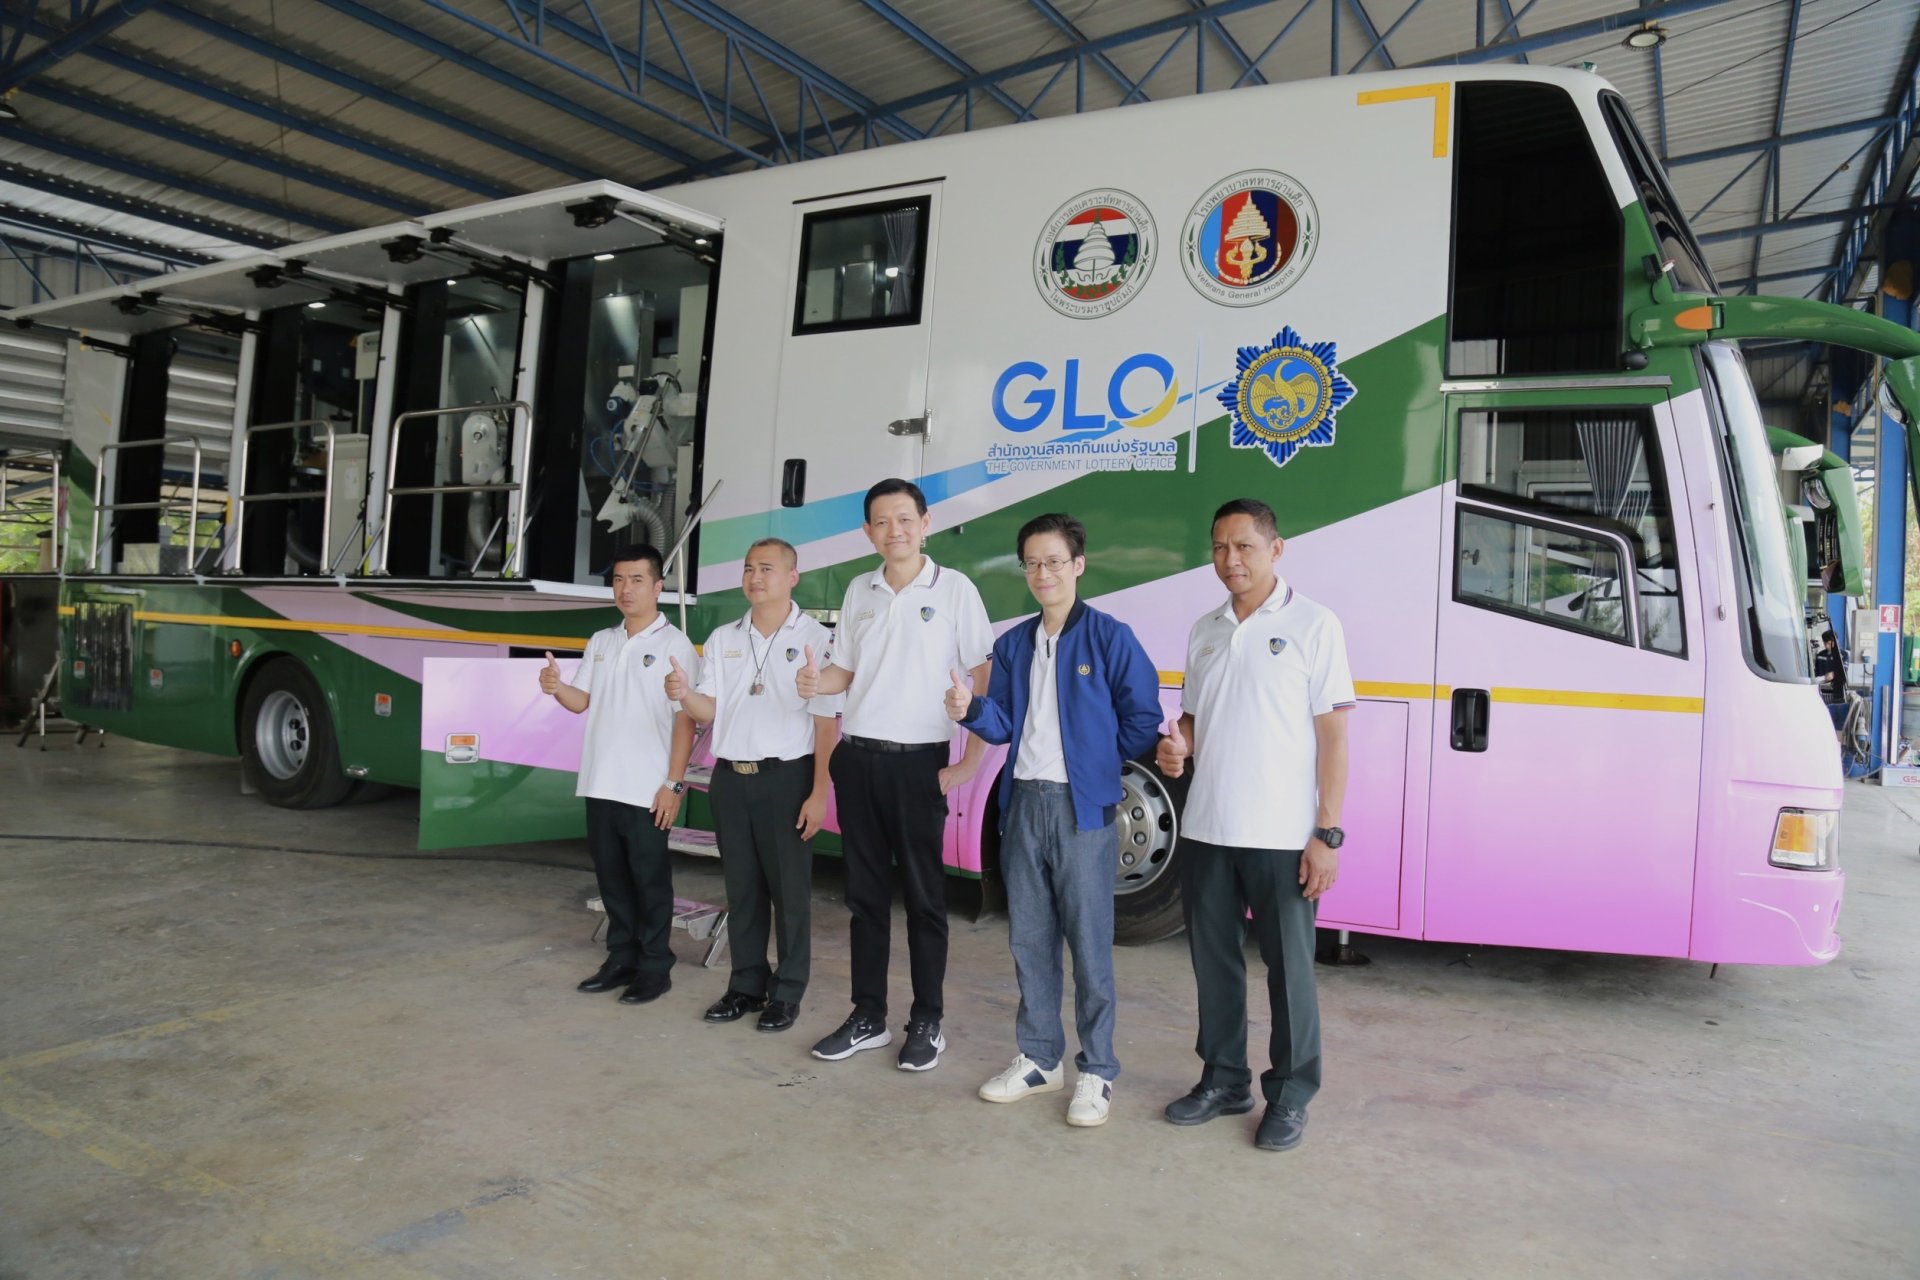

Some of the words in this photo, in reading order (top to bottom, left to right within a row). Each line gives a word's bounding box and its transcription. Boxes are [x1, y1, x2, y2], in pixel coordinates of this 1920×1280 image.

[1194, 177, 1304, 218] โรงพยาบาลทหารผ่านศึก
[1196, 271, 1226, 297] Veterans
[1227, 289, 1261, 299] General
[1263, 267, 1296, 293] Hospital
[991, 353, 1179, 432] GLO
[988, 438, 1176, 458] สำนักงานสลากกินแบ่งรัฐบาล
[988, 461, 1006, 473] THE
[1010, 459, 1081, 472] GOVERNMENT
[1086, 458, 1133, 470] LOTTERY
[1135, 457, 1174, 469] OFFICE
